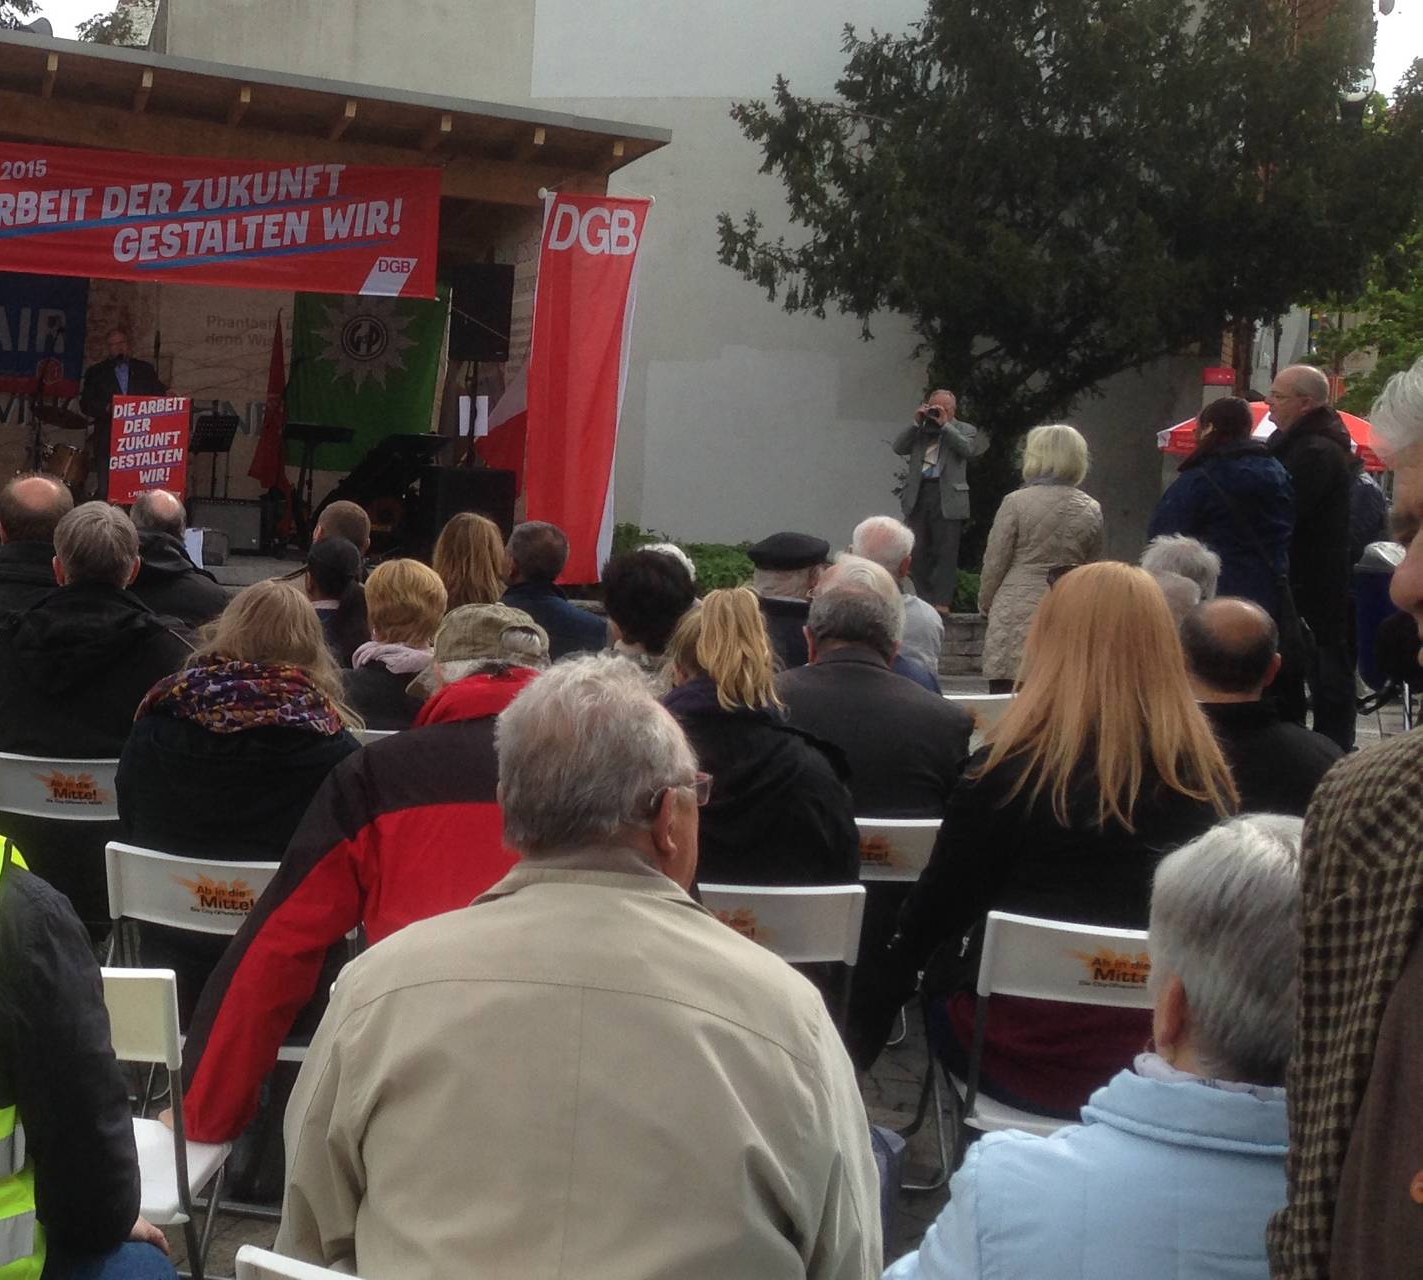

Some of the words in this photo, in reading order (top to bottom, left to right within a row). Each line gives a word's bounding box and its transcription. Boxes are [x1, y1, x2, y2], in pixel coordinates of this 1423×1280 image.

[0, 160, 47, 180] 2015
[100, 182, 172, 219] DER
[178, 163, 346, 212] ZUKUNFT
[113, 210, 309, 262] GESTALTEN
[323, 198, 403, 241] WIR!
[548, 203, 637, 256] DGB
[378, 259, 411, 274] DGB
[113, 403, 136, 418] DIE
[137, 397, 186, 415] ARBEIT
[123, 418, 151, 434] DER
[116, 431, 181, 452] ZUKUNFT
[109, 448, 183, 470] GESTALTEN
[139, 467, 171, 484] WIR!
[197, 885, 211, 895] Ab
[228, 888, 246, 897] die
[200, 895, 254, 911] Mitte!
